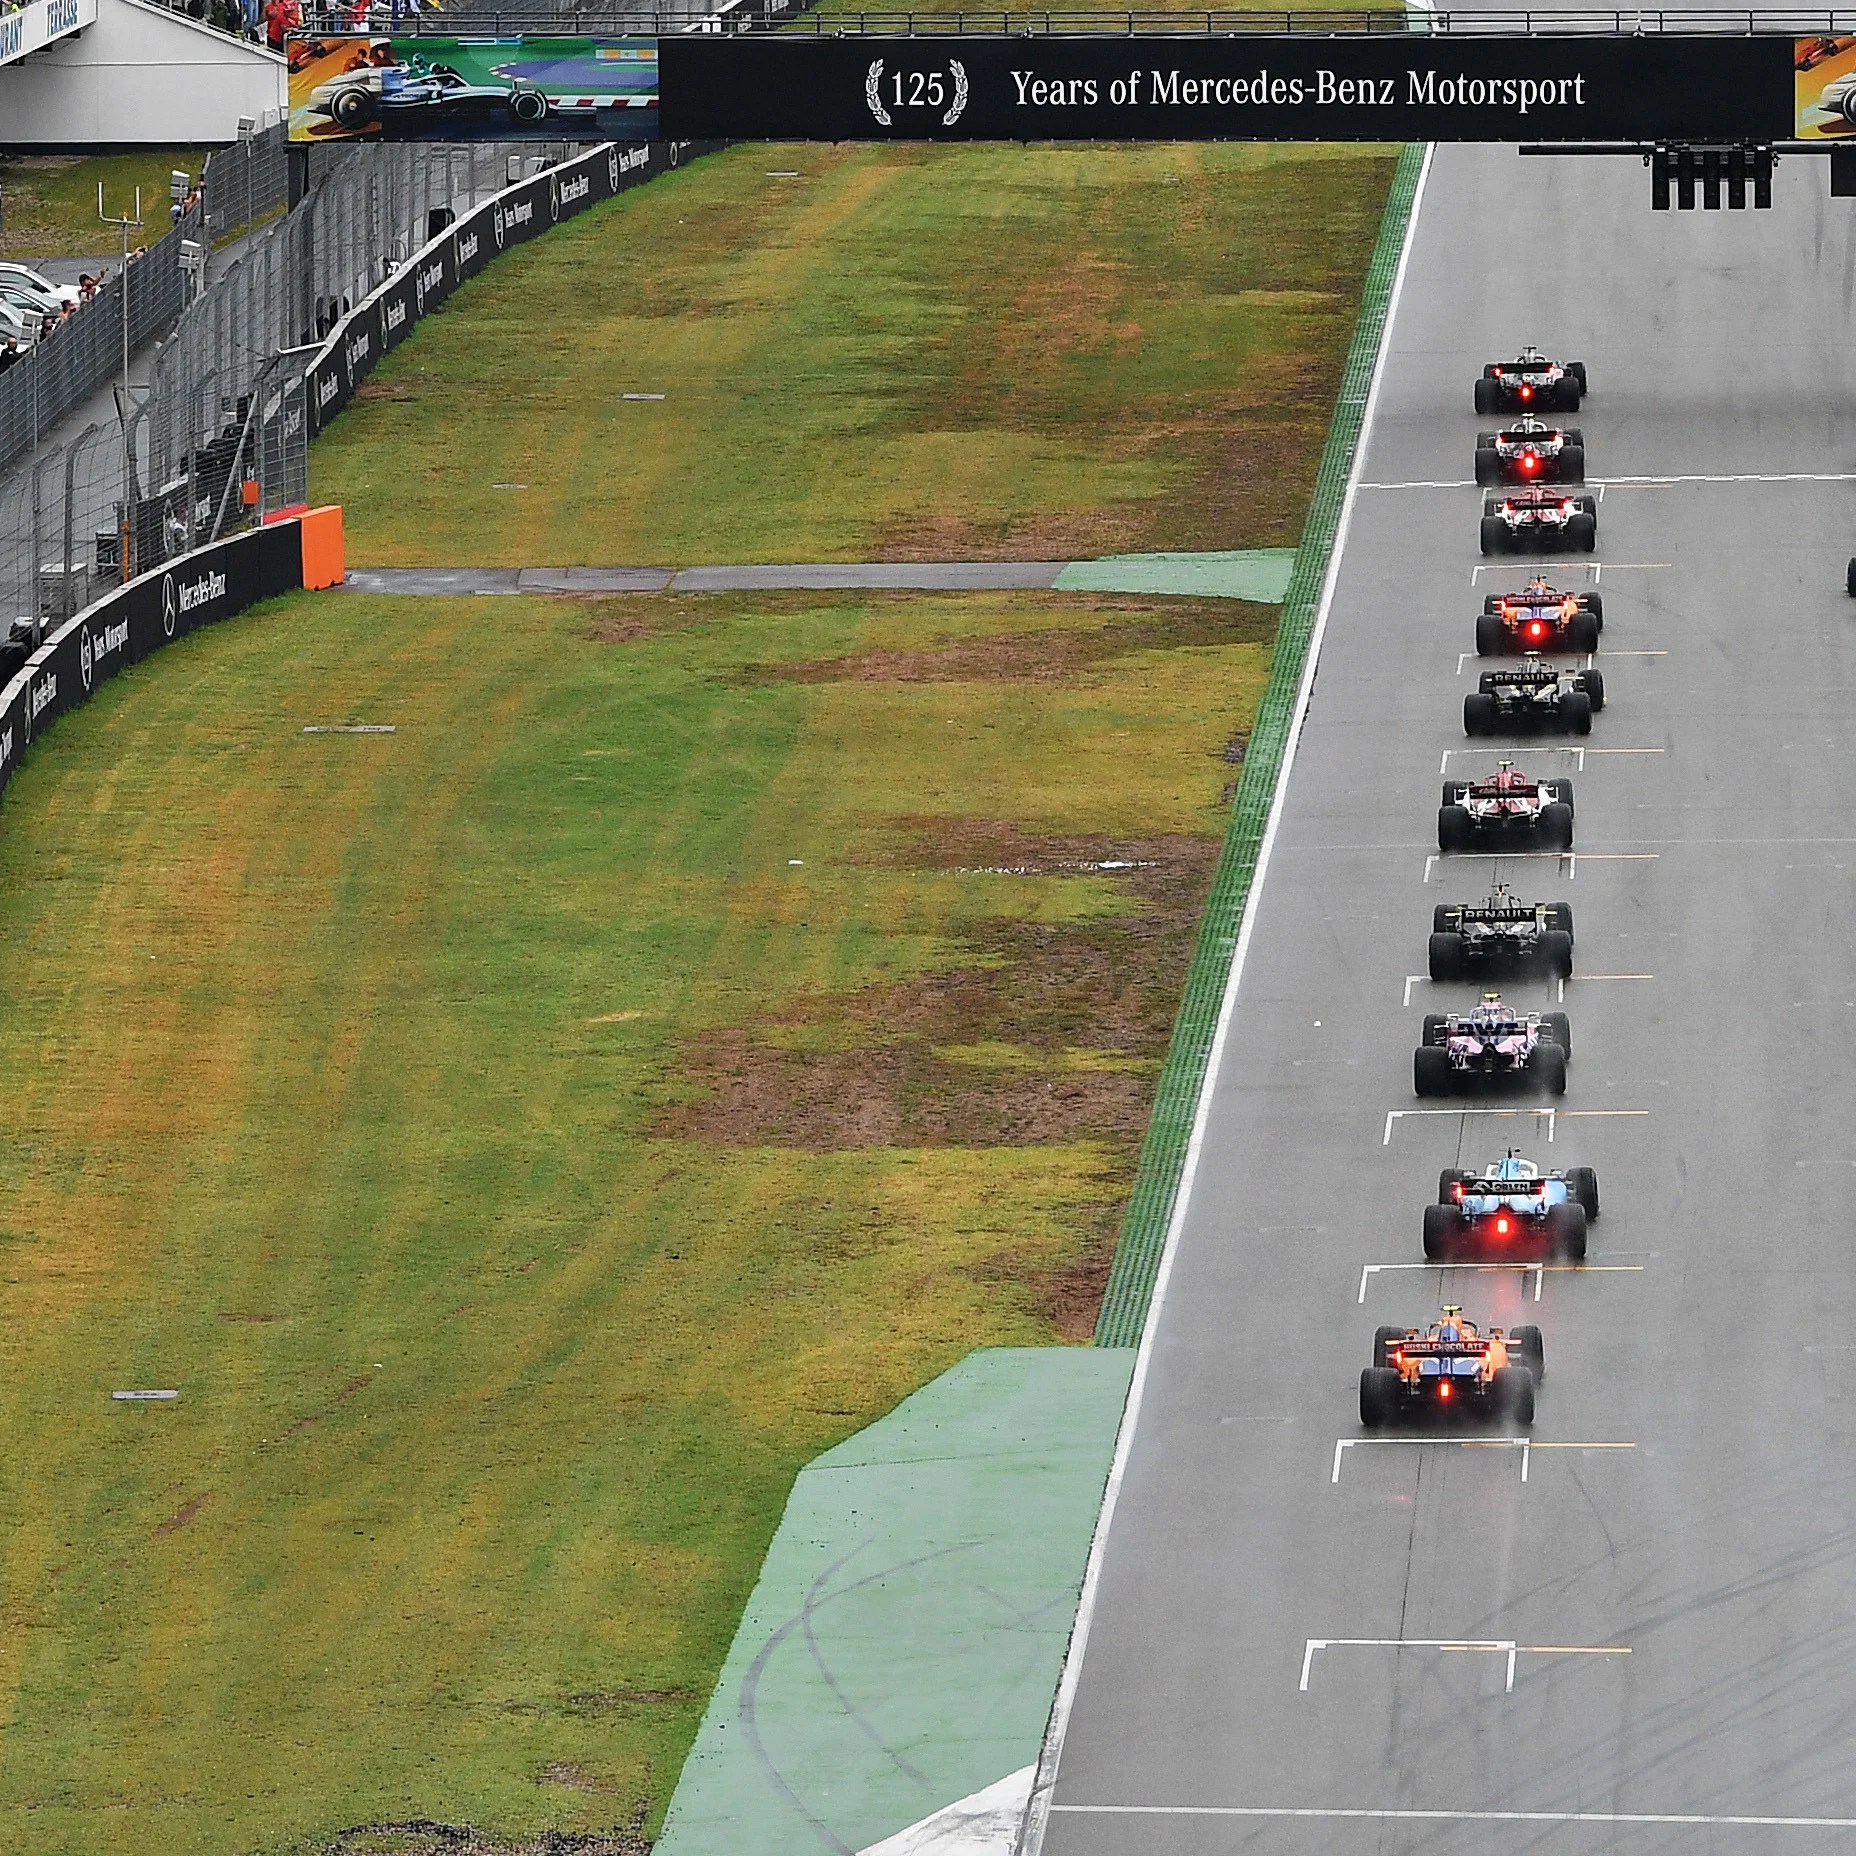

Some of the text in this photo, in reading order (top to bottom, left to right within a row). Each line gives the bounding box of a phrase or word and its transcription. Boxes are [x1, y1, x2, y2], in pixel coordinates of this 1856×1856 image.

[892, 70, 1587, 114] 125 Years of Mercedes-Benz Motorsport
[179, 570, 227, 614] Mercedes-Benz
[1494, 674, 1555, 682] RENAULT
[1464, 909, 1533, 919] RENAULT
[1494, 1182, 1529, 1192] ORLEN
